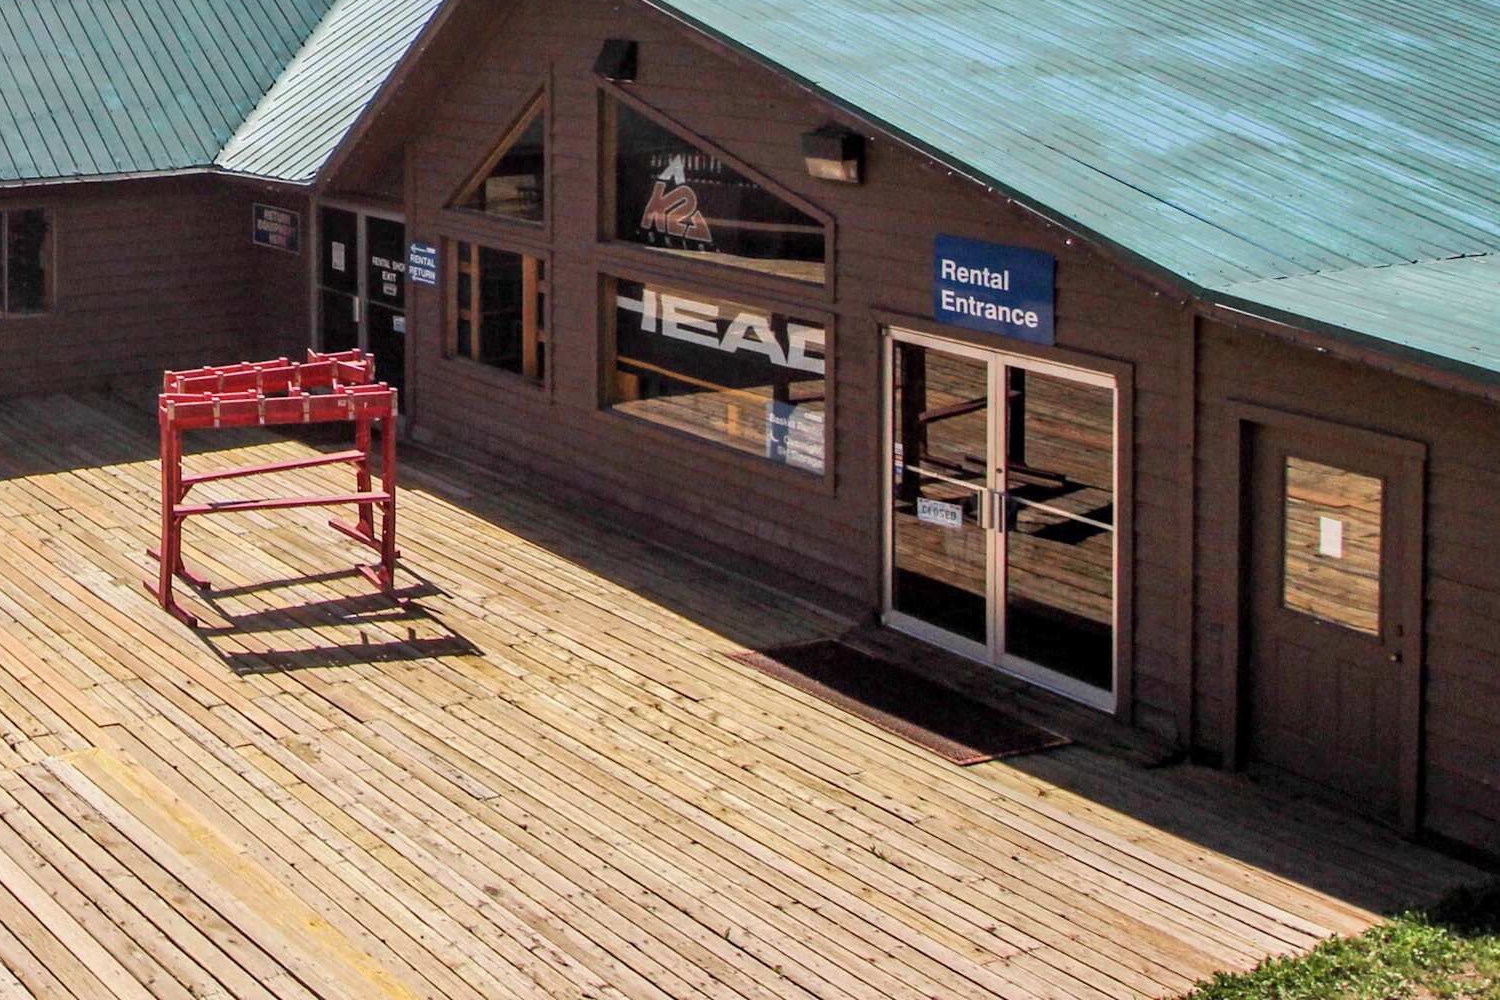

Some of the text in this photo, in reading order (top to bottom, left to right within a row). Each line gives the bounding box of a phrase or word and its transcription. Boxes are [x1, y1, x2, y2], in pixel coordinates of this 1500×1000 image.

[372, 256, 391, 269] RENTAL
[410, 253, 436, 268] RENTAL
[382, 271, 397, 283] EXIT
[409, 265, 436, 280] RETURN
[941, 258, 1010, 291] Rental
[941, 289, 1039, 328] Entrance
[921, 505, 957, 521] CLOSED
